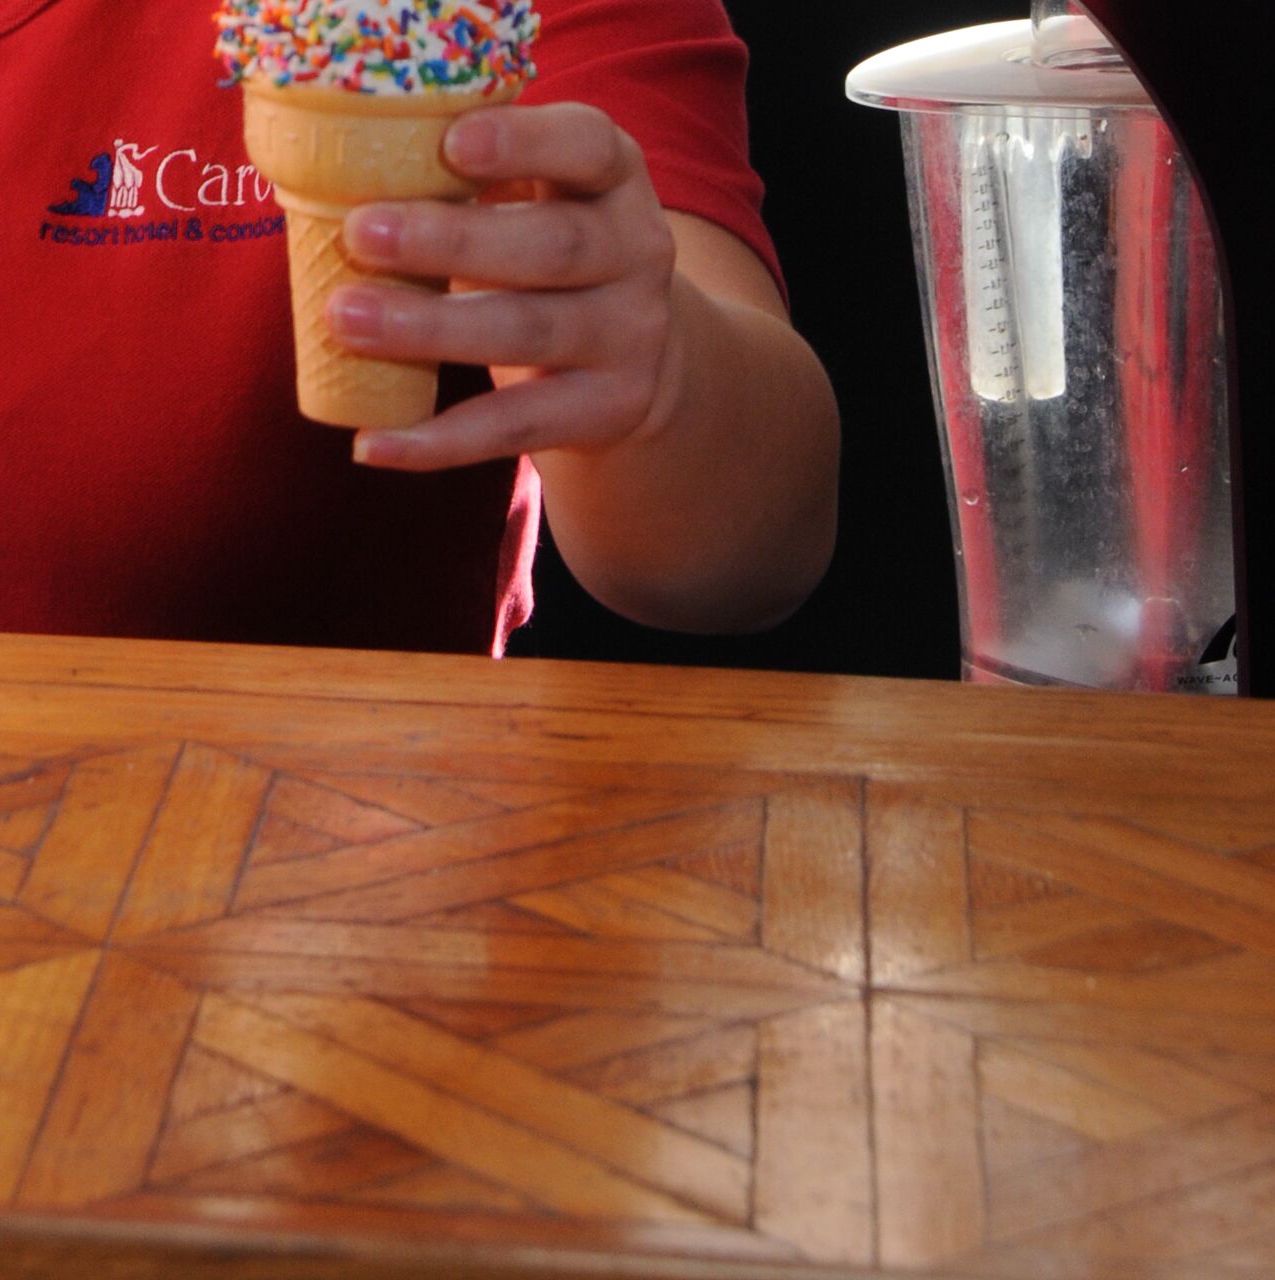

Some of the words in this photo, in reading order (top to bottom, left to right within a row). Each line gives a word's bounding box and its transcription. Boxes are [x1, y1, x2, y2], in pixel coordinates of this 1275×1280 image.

[155, 148, 277, 212] Caro
[39, 219, 119, 246] resort
[125, 219, 178, 244] hotel
[185, 217, 203, 242] &
